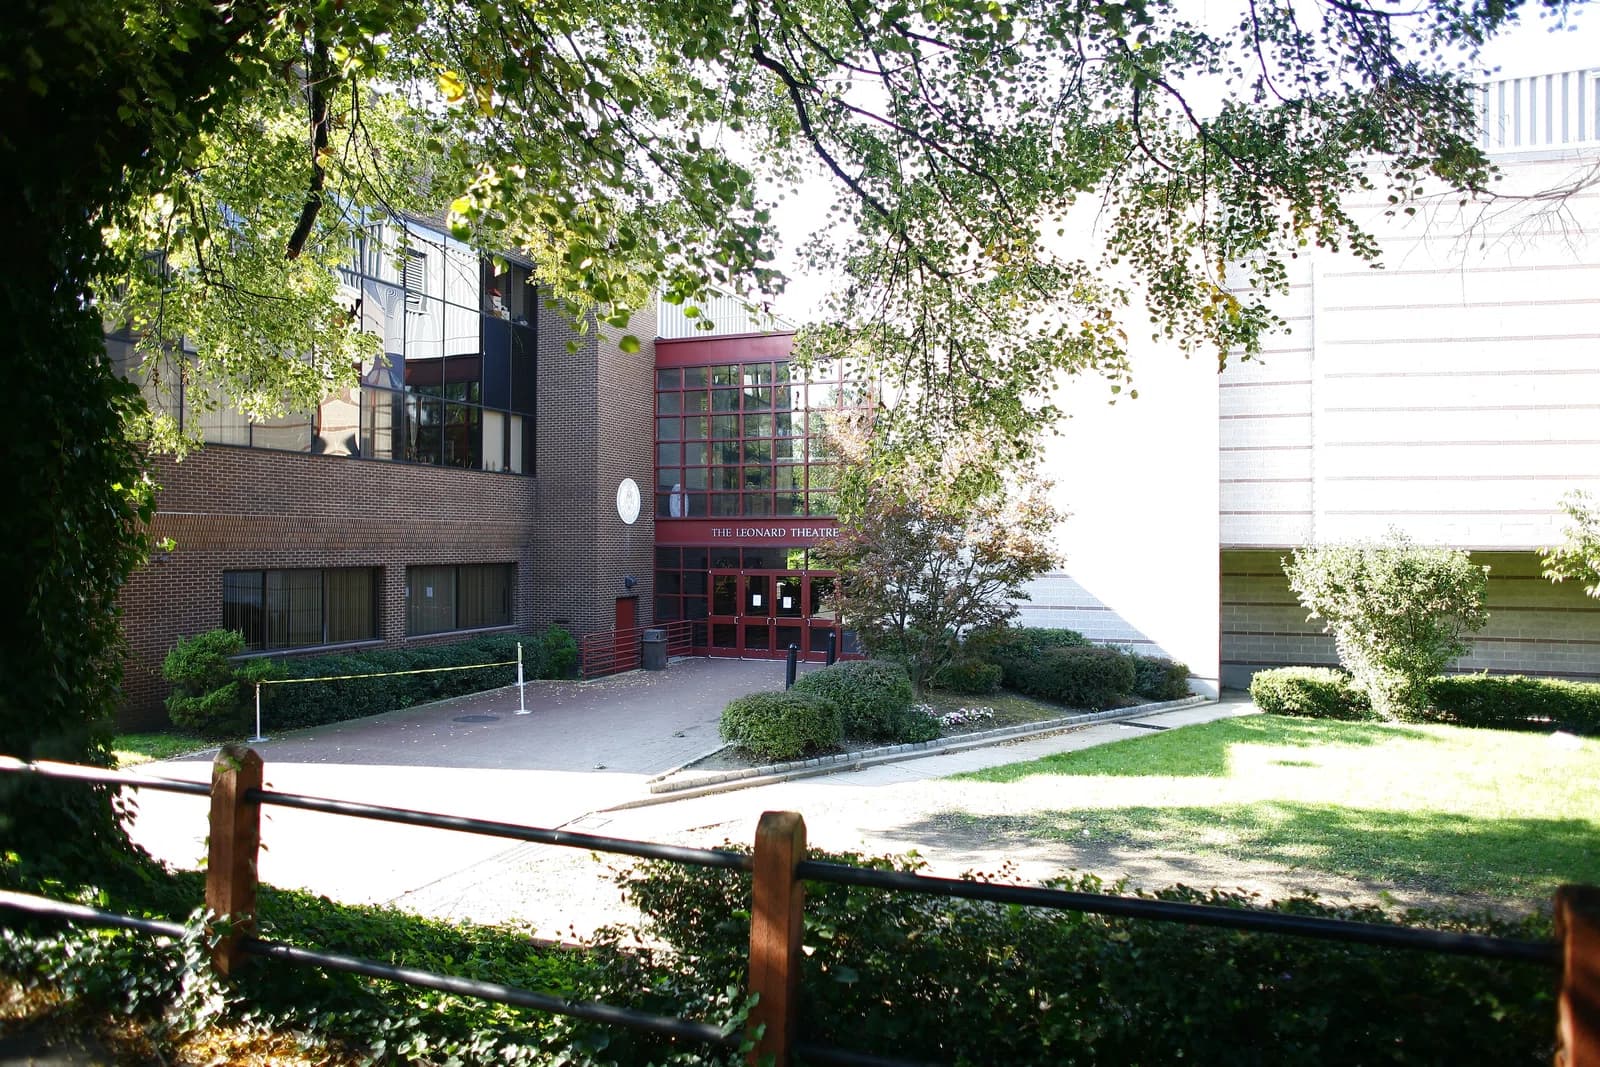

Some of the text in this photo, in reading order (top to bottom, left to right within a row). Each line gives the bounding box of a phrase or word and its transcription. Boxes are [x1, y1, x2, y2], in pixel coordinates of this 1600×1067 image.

[711, 528, 840, 537] THE LEONARD THEATRE
